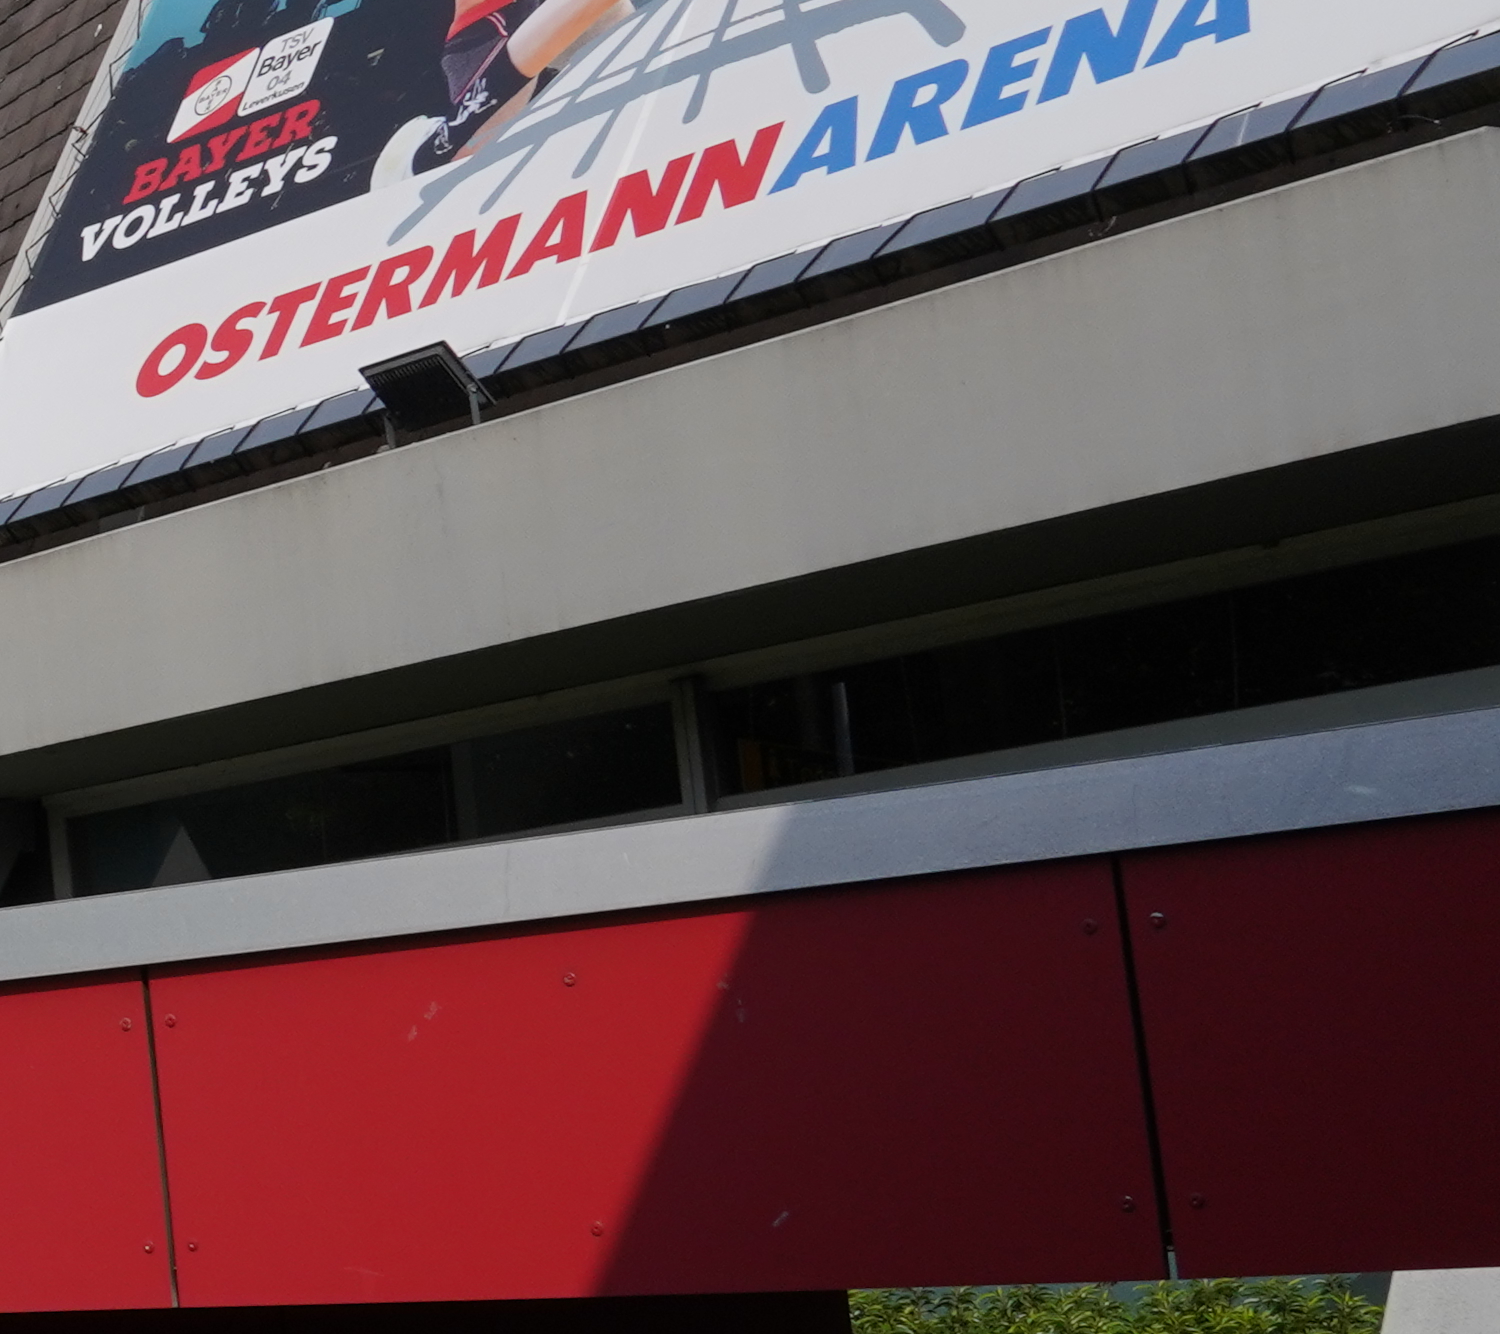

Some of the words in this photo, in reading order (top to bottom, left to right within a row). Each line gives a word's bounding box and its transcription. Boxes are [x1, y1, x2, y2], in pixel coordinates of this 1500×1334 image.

[257, 40, 322, 78] Bayer
[282, 28, 314, 53] TSV
[267, 71, 292, 91] 04
[122, 99, 321, 205] BAYER
[80, 136, 339, 262] VOLLEYS
